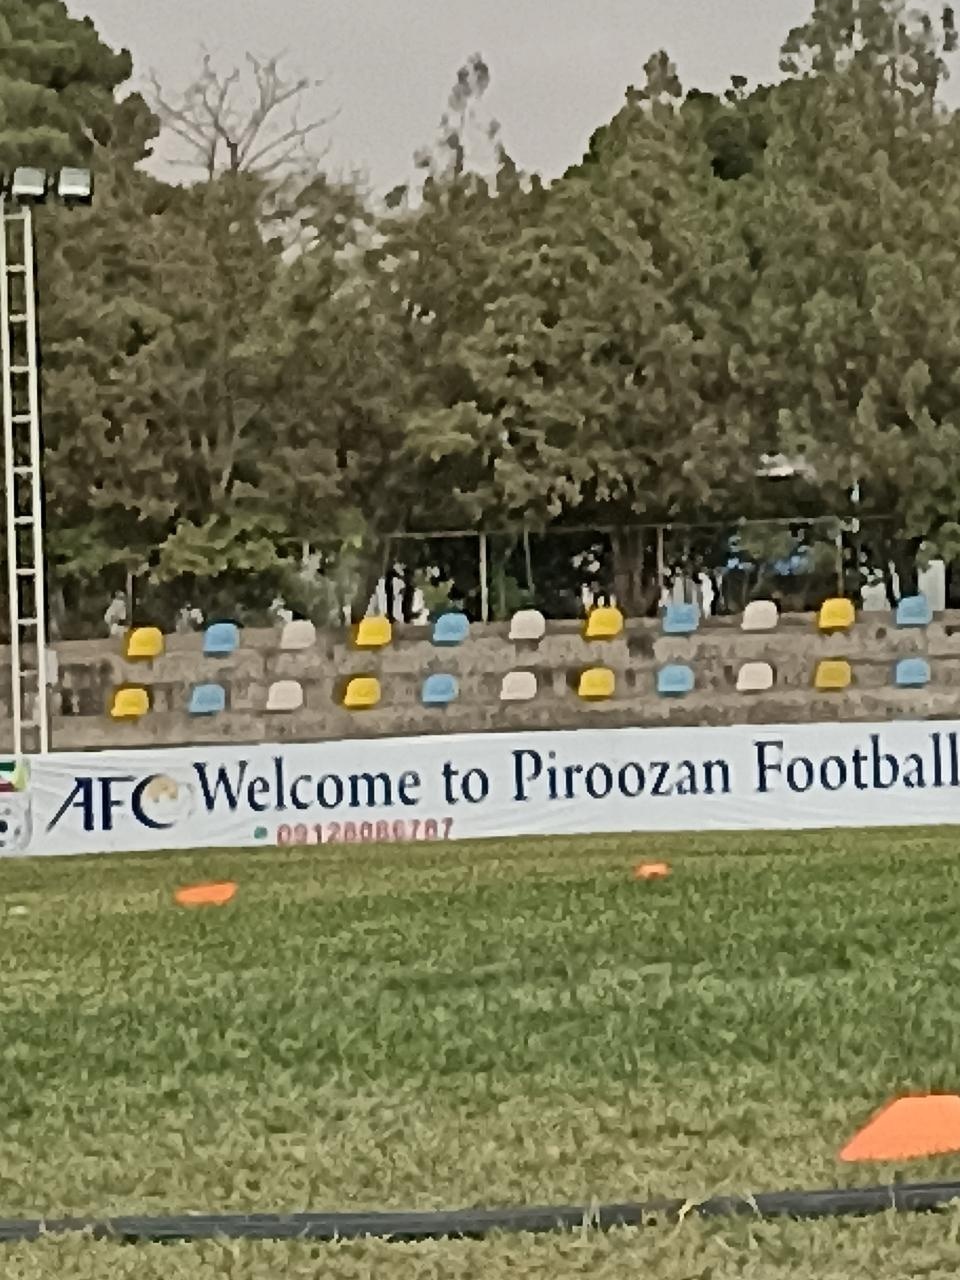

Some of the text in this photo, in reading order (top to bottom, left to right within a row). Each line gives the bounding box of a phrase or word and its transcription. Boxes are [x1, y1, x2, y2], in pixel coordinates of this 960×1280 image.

[45, 773, 178, 832] AFC
[193, 756, 422, 812] Welcome
[441, 761, 490, 805] to
[512, 748, 731, 801] Piroozan
[753, 732, 960, 793] Football
